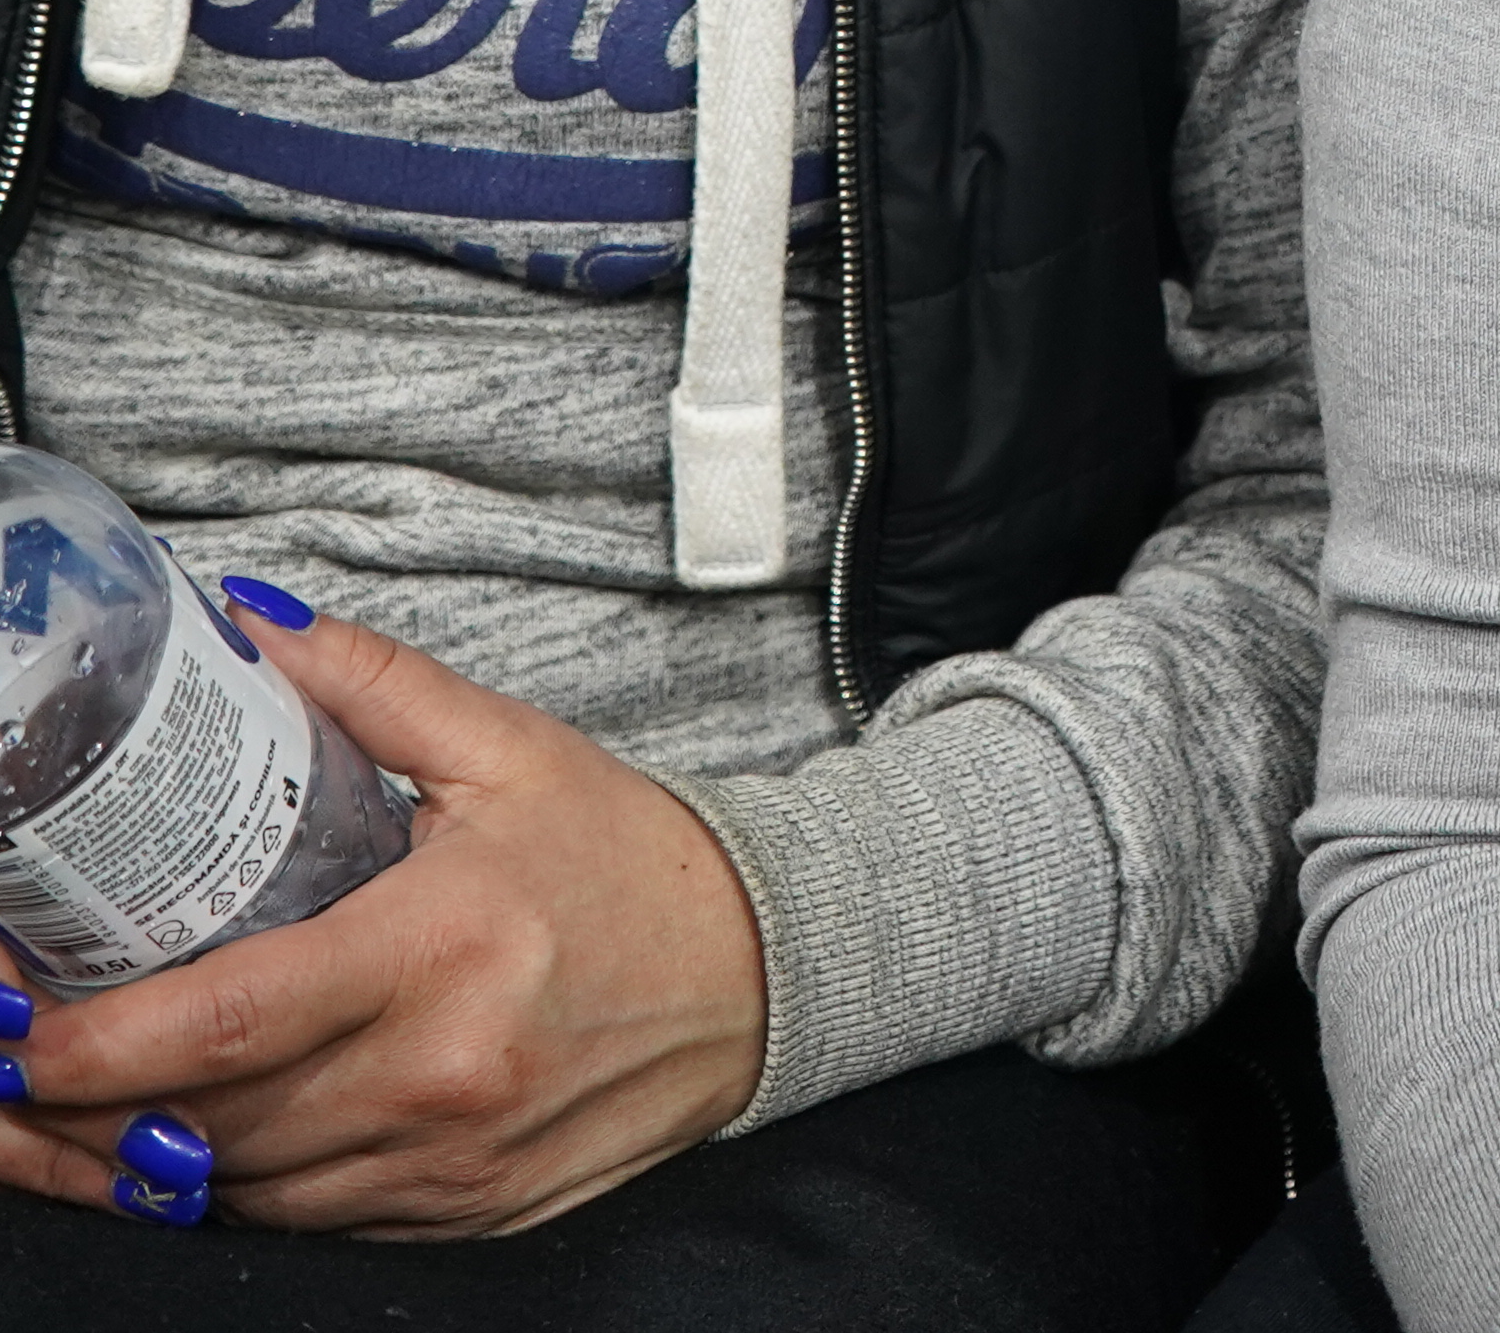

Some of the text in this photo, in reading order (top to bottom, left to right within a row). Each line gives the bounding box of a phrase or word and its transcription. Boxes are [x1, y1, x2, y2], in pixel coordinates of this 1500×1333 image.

[146, 724, 161, 748] Gura
[201, 782, 216, 804] com.
[216, 754, 228, 778] Gura
[133, 737, 276, 927] SE RECOMANDĂ ȘI COPIILOR
[166, 864, 178, 875] cu
[178, 836, 205, 864] sistem
[203, 823, 214, 836] de
[122, 832, 220, 917] alimentelor FSSC 22000
[195, 871, 229, 903] Ambalaj
[227, 860, 237, 871] de
[236, 833, 255, 860] unică
